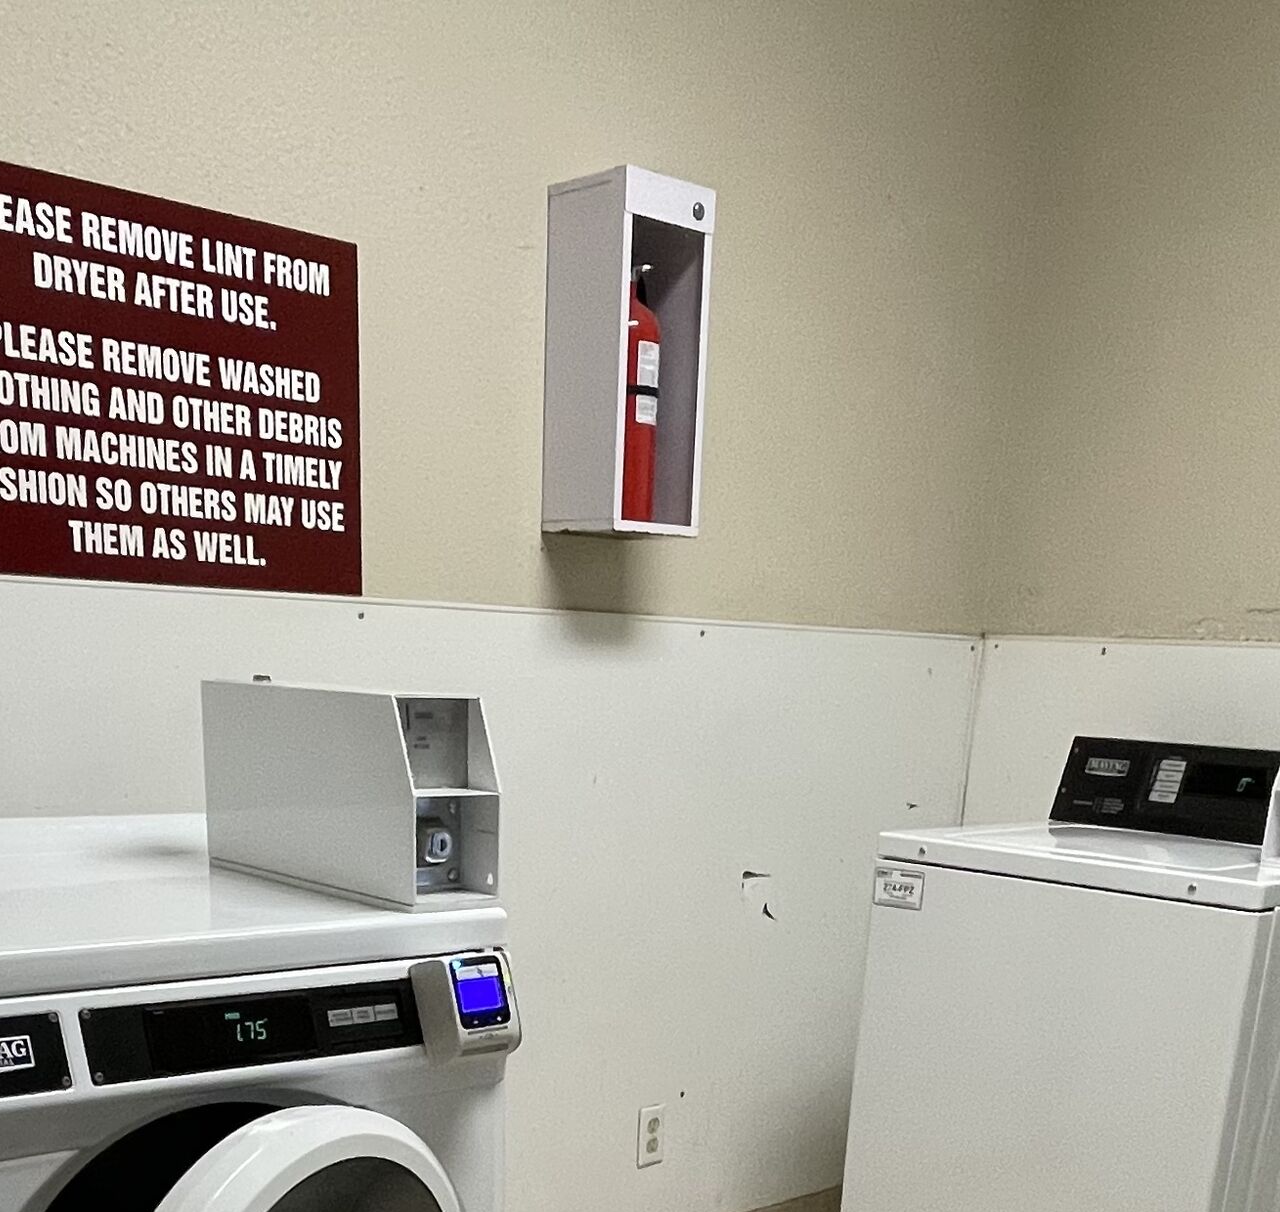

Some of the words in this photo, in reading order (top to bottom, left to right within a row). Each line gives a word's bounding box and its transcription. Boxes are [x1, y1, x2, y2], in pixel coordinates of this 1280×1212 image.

[81, 212, 194, 268] REMOVE
[202, 238, 256, 280] LINT
[264, 252, 329, 296] FROM
[33, 252, 125, 302] DRYER
[134, 272, 213, 318] AFTER
[222, 293, 277, 331] USE.
[102, 338, 210, 387] REMOVE
[218, 357, 320, 402] WASHED
[109, 387, 164, 424] AND
[173, 396, 251, 437] OTHER
[259, 408, 342, 449] DEBRIS
[56, 426, 198, 473] MACHINES
[206, 445, 232, 478] IN
[240, 450, 256, 480] A
[263, 452, 342, 490] TIMELY
[96, 477, 131, 511] SO
[141, 487, 237, 521] OTHERS
[244, 493, 294, 526] MAY
[302, 499, 344, 531] USE
[68, 520, 144, 557] THEM
[152, 528, 186, 560] AS
[193, 531, 266, 566] WELL.
